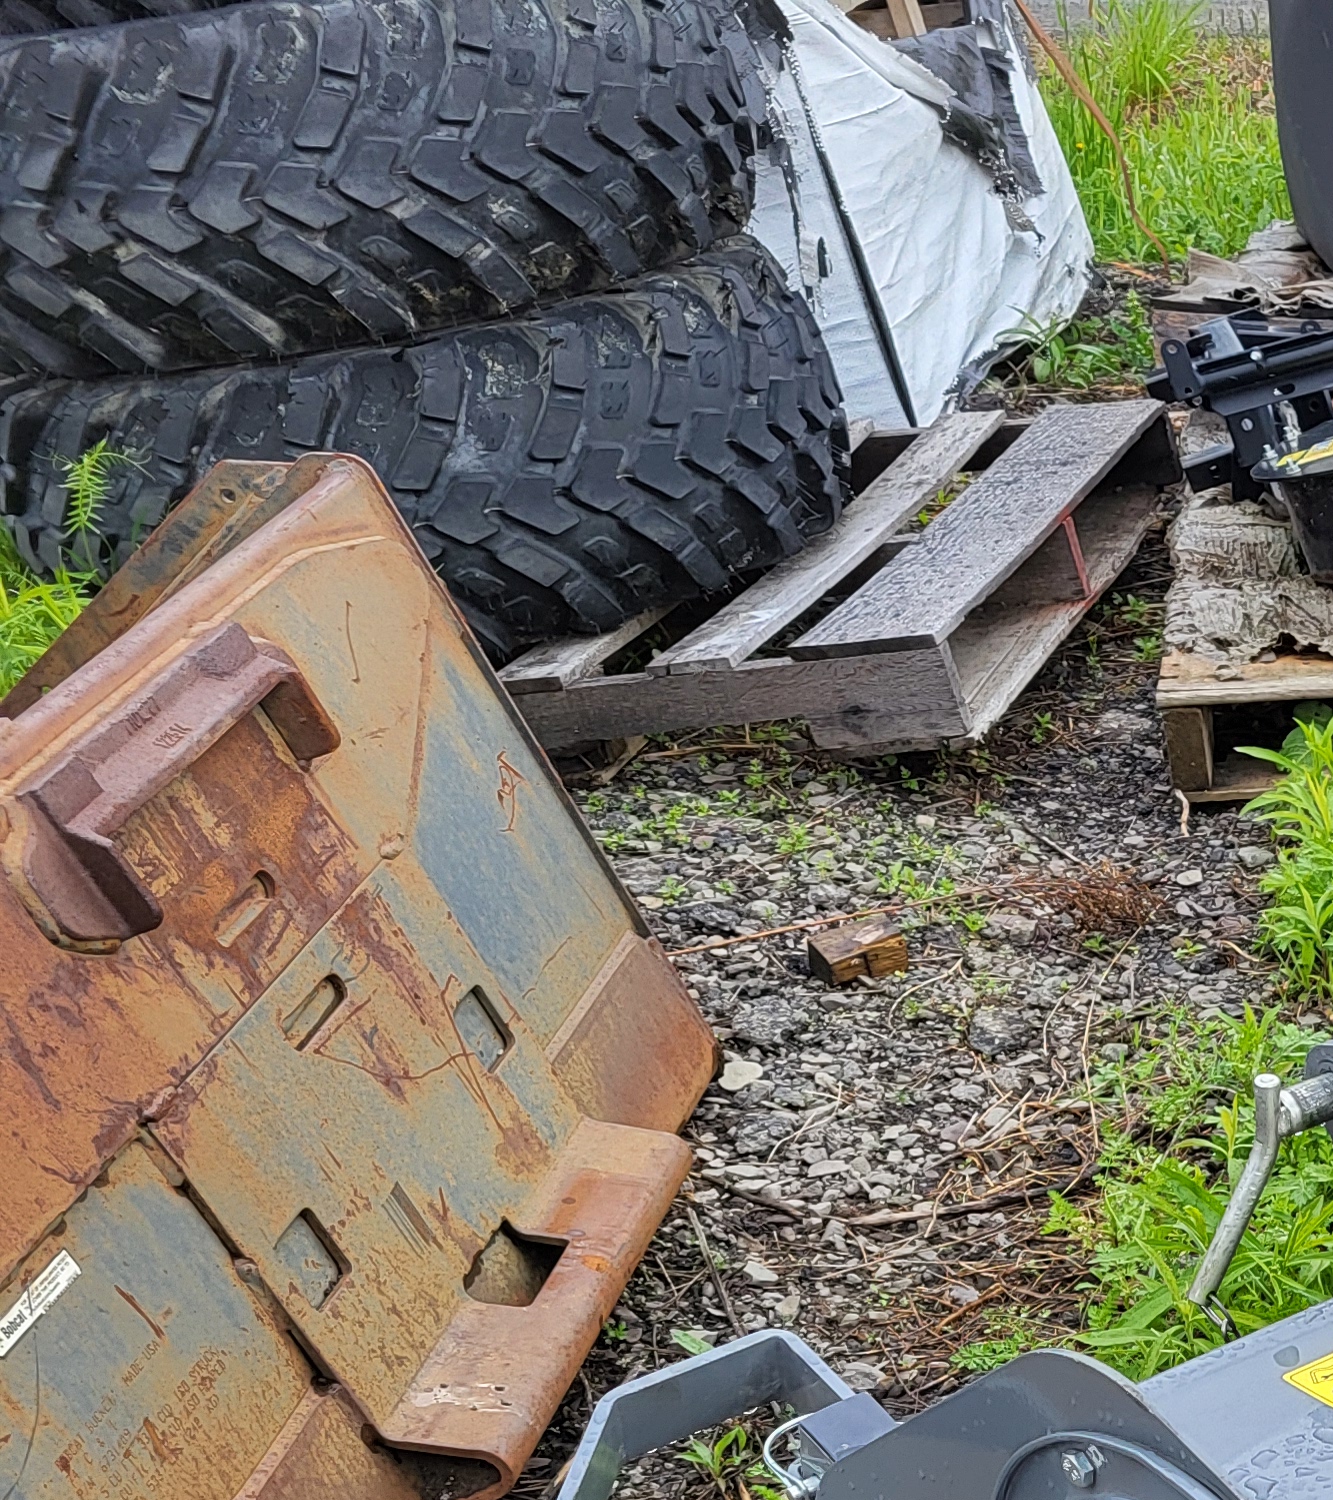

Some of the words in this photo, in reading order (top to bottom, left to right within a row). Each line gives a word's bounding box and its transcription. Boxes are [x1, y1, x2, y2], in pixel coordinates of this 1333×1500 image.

[0, 1309, 28, 1339] Bobcat
[121, 1359, 143, 1386] MADE
[141, 1338, 159, 1360] USA
